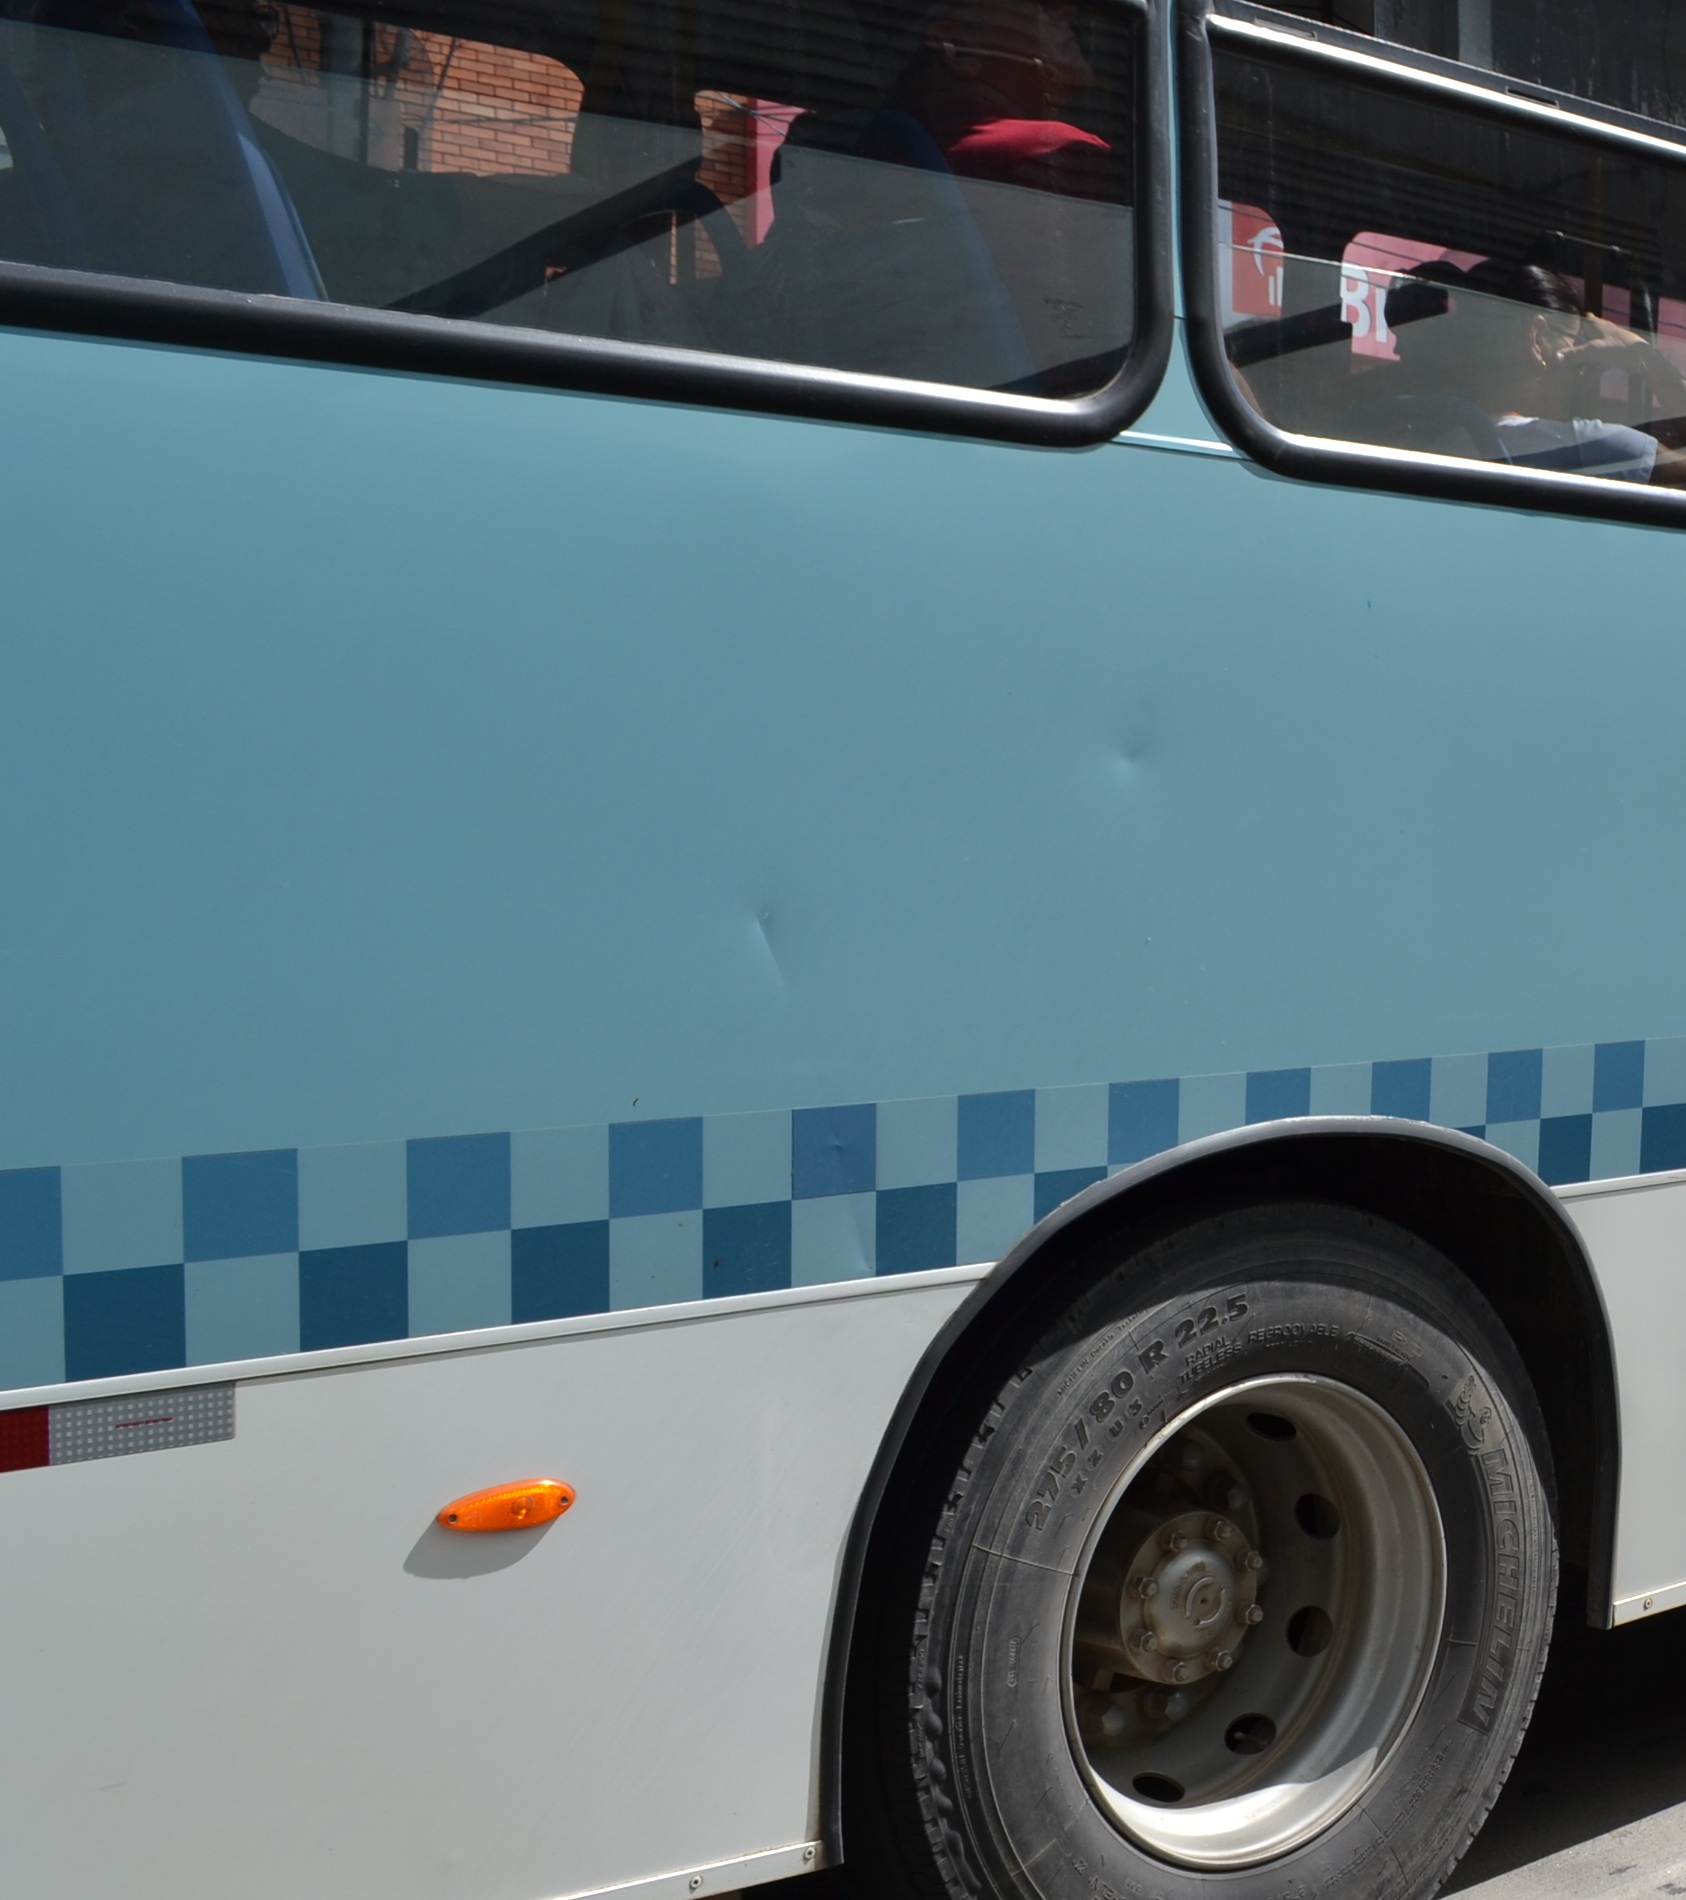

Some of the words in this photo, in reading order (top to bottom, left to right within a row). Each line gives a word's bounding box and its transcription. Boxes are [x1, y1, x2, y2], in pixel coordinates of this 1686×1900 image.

[1138, 1339, 1170, 1375] R
[1174, 1293, 1250, 1349] 22.5
[1178, 1342, 1243, 1384] TUBELESS
[1185, 1335, 1232, 1367] RADIAL
[1472, 1448, 1523, 1729] MICHELIN
